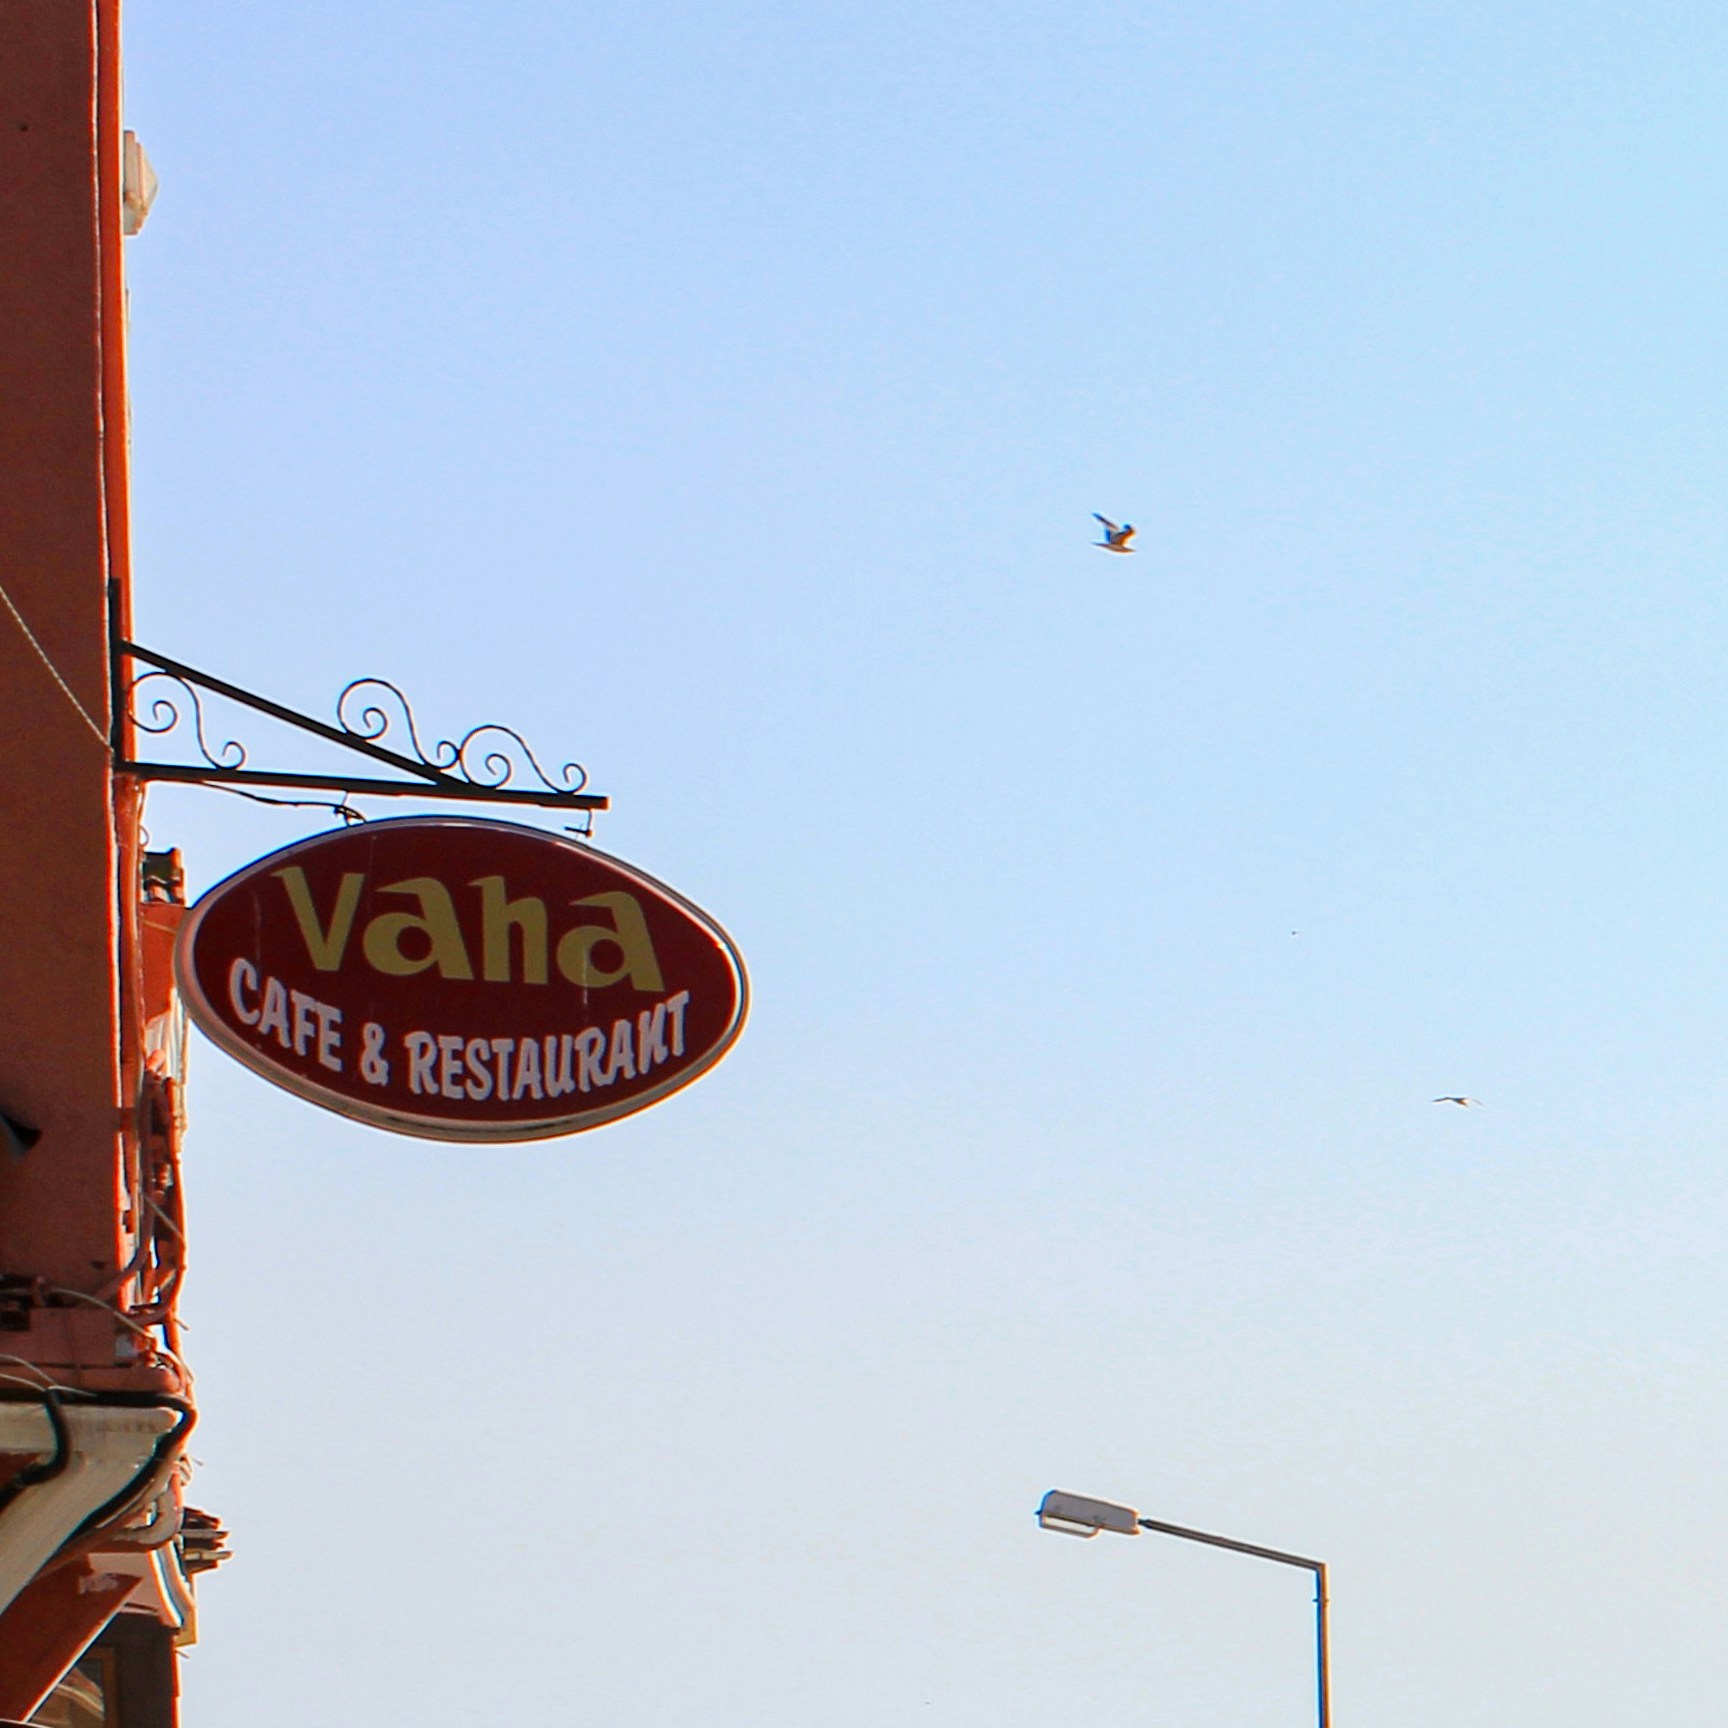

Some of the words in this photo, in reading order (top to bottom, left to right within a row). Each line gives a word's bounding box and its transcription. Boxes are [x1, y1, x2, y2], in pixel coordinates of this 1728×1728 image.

[270, 866, 666, 992] Vaha
[228, 957, 343, 1072] CAFE
[360, 1021, 390, 1087] &
[404, 990, 690, 1102] RESTAURANT
